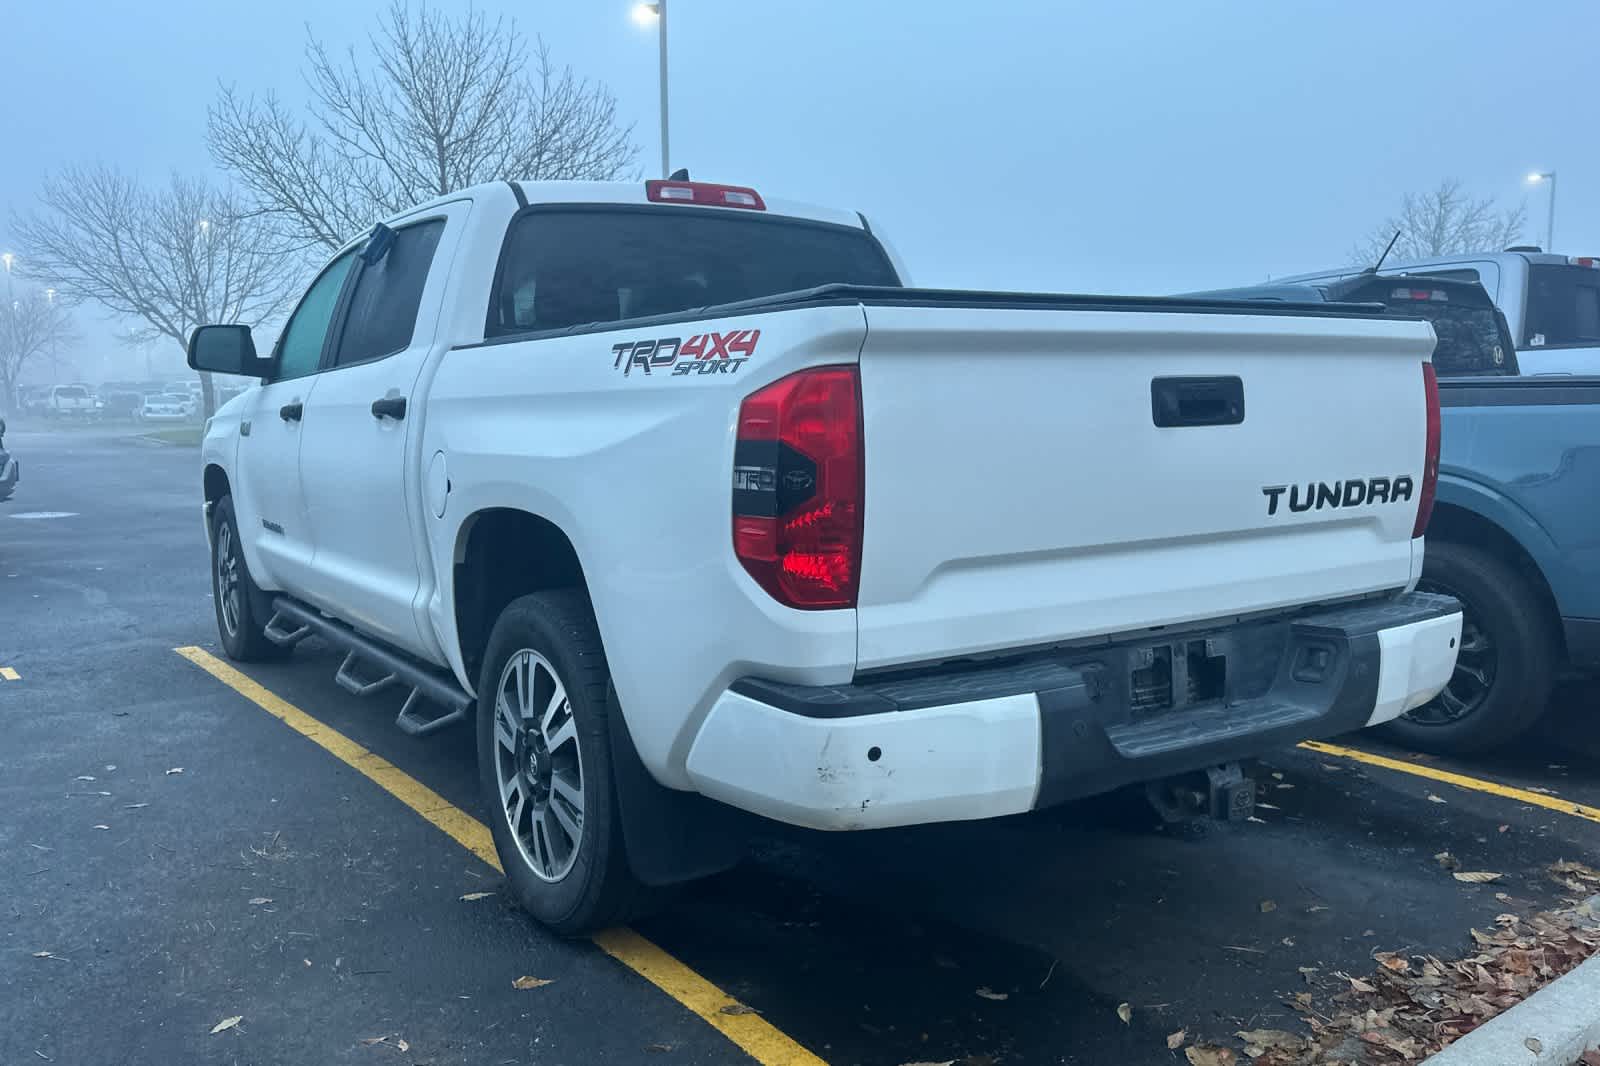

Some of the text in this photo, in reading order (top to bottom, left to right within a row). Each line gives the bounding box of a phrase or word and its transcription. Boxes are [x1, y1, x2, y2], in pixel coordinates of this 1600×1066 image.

[612, 337, 682, 376] TRD
[671, 358, 749, 376] SPORT
[1262, 475, 1413, 515] TUNDRA
